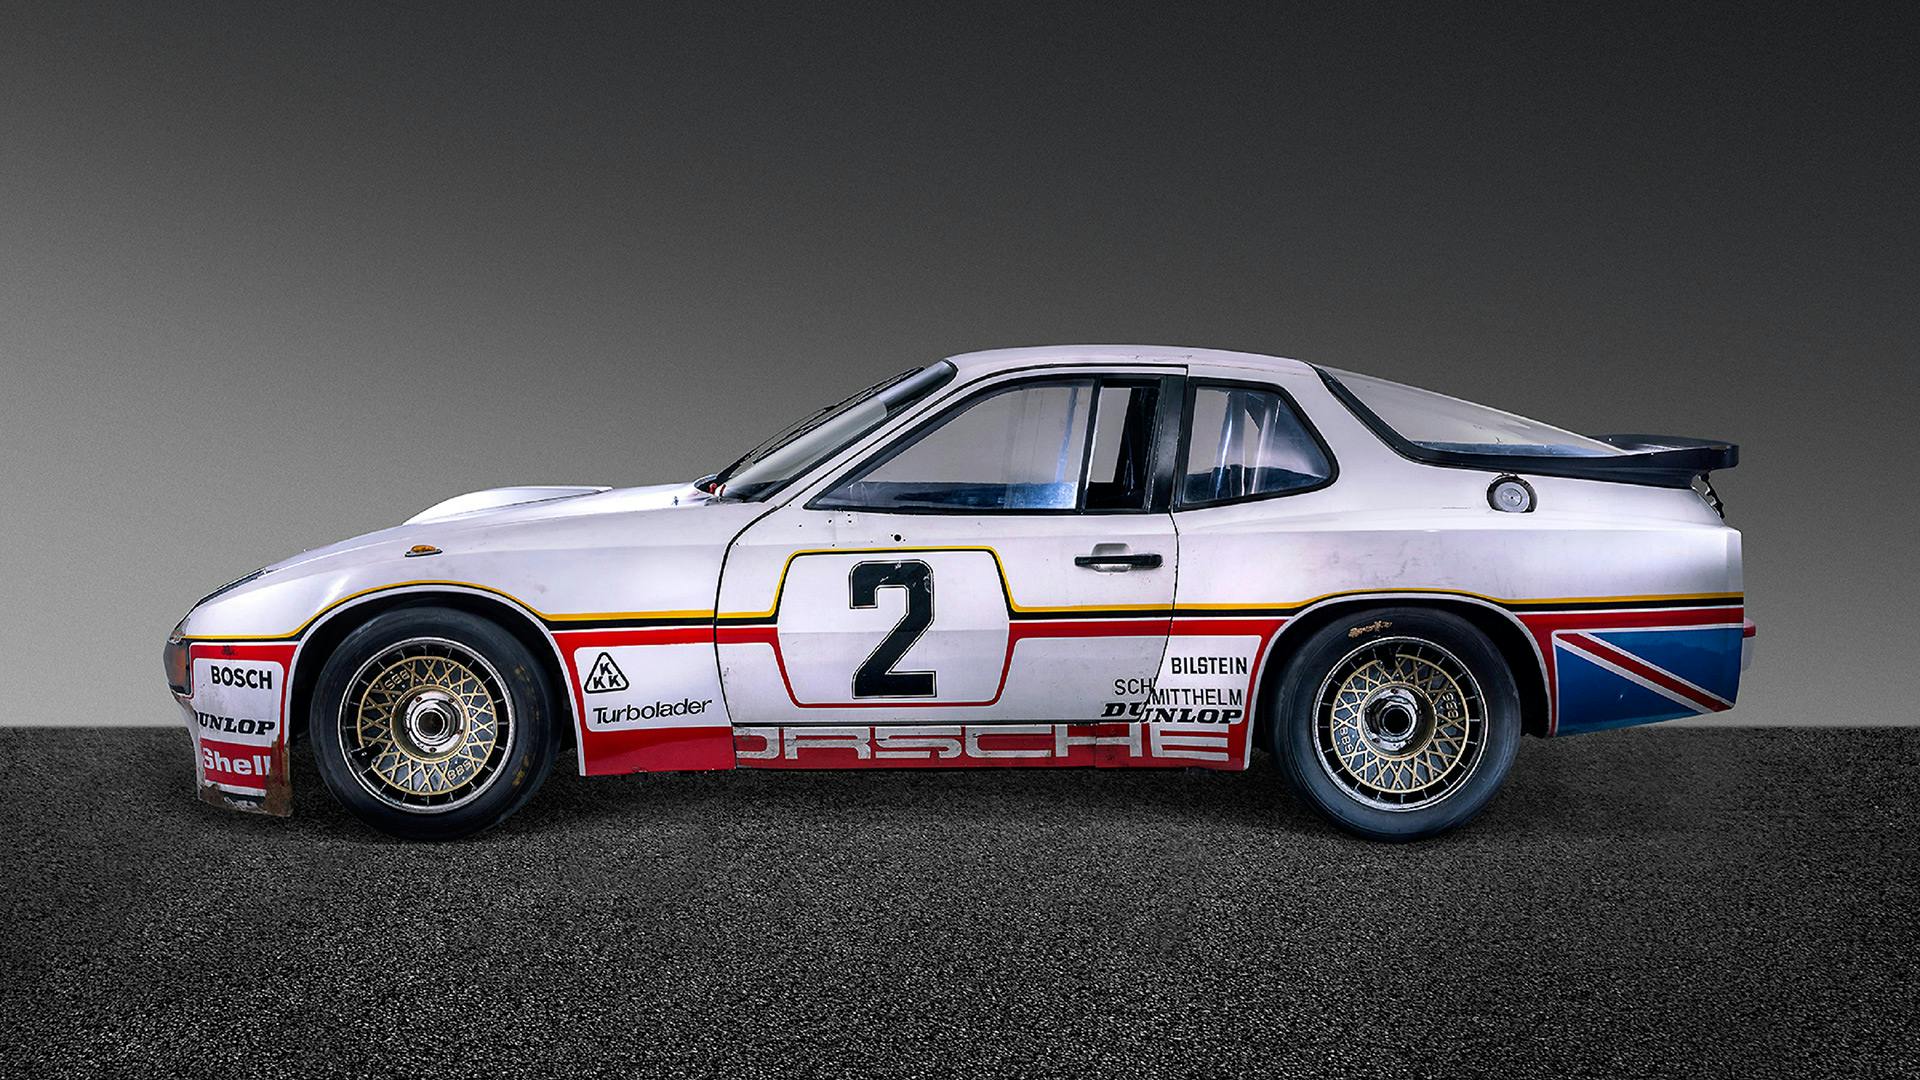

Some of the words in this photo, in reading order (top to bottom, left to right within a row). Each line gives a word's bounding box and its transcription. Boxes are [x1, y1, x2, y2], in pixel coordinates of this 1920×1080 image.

[848, 559, 937, 700] 2
[210, 665, 273, 690] BOSCH
[1171, 657, 1248, 675] BILSTEIN
[593, 698, 713, 725] Turbolader
[1101, 702, 1243, 724] DUNLOP
[202, 747, 271, 777] Shell
